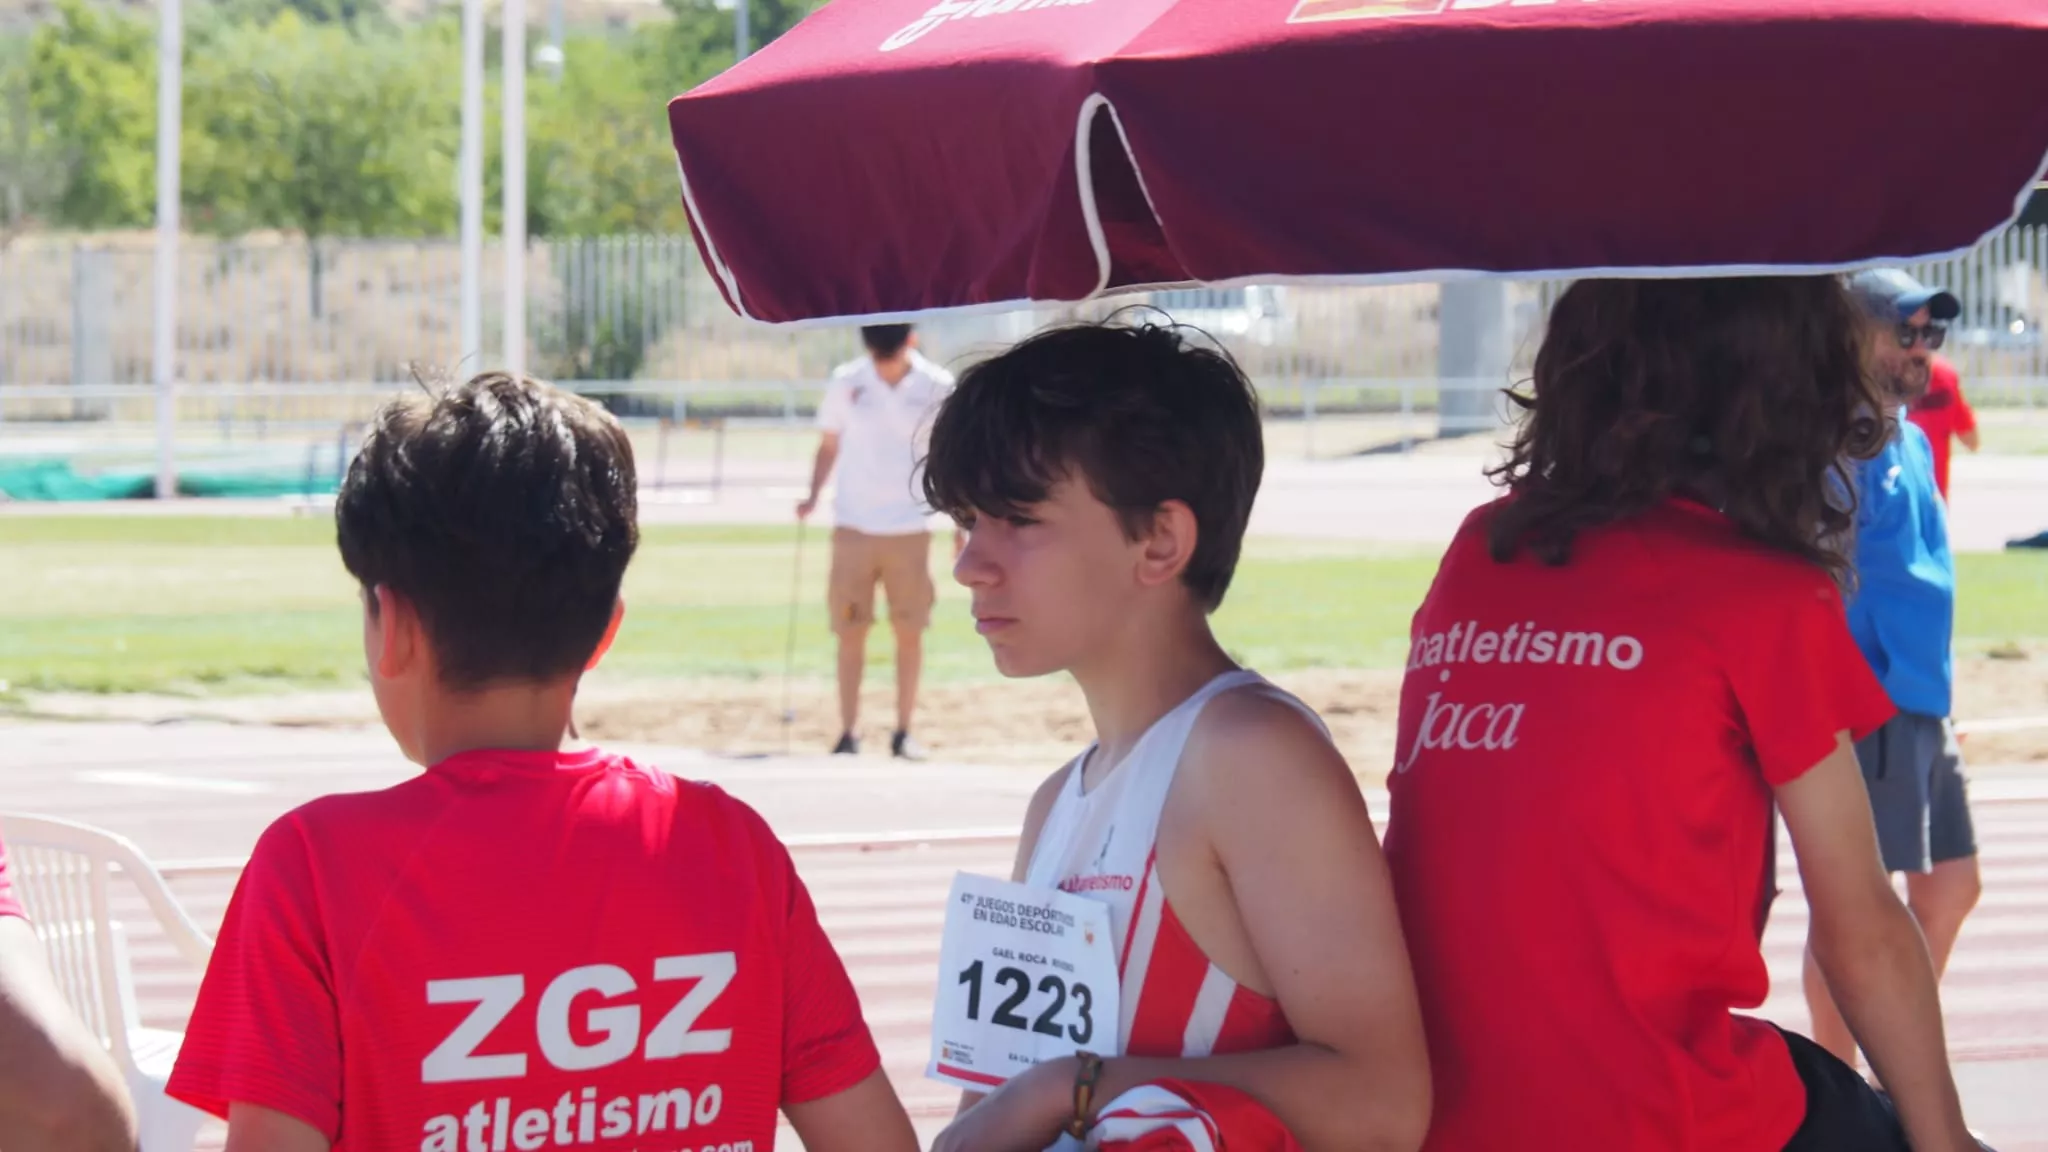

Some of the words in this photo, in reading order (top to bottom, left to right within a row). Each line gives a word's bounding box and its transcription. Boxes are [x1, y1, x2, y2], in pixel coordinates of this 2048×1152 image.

[1406, 621, 1644, 671] batletismo
[1396, 669, 1526, 774] jaca
[973, 908, 988, 922] EN
[990, 912, 1018, 928] EDAD
[976, 896, 1015, 914] JUEGOS
[991, 946, 1016, 960] GAEL
[1018, 952, 1048, 966] ROCA
[421, 951, 738, 1084] ZGZ
[957, 959, 1094, 1045] 1223
[419, 1083, 723, 1152] atletismo
